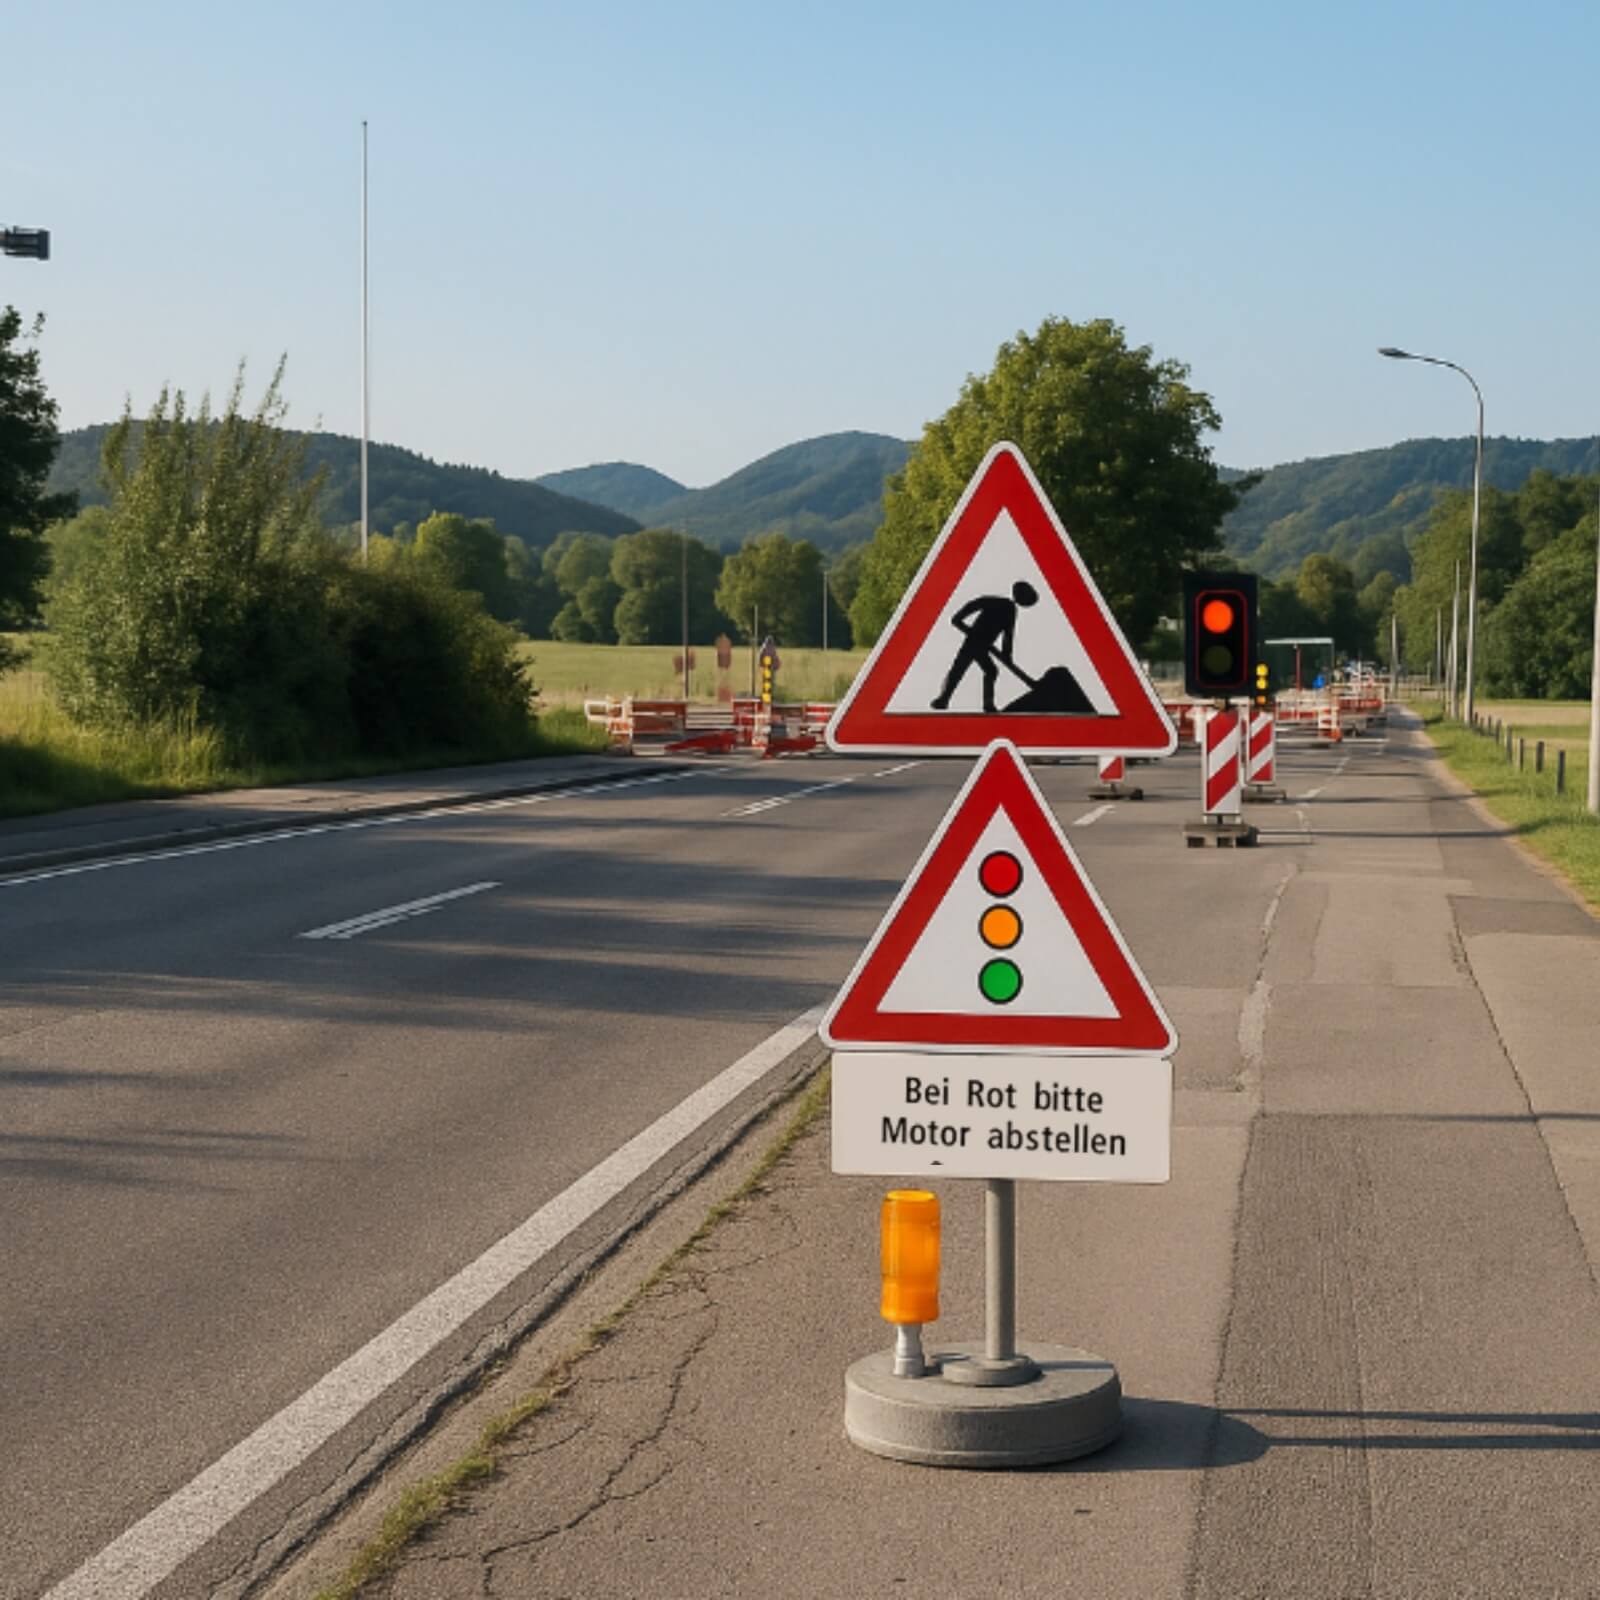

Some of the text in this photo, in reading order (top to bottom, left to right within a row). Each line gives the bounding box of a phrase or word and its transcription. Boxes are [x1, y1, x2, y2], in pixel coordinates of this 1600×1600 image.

[905, 1076, 1104, 1114] Bei Rot bitte
[881, 1116, 1126, 1156] Motor abstellen
